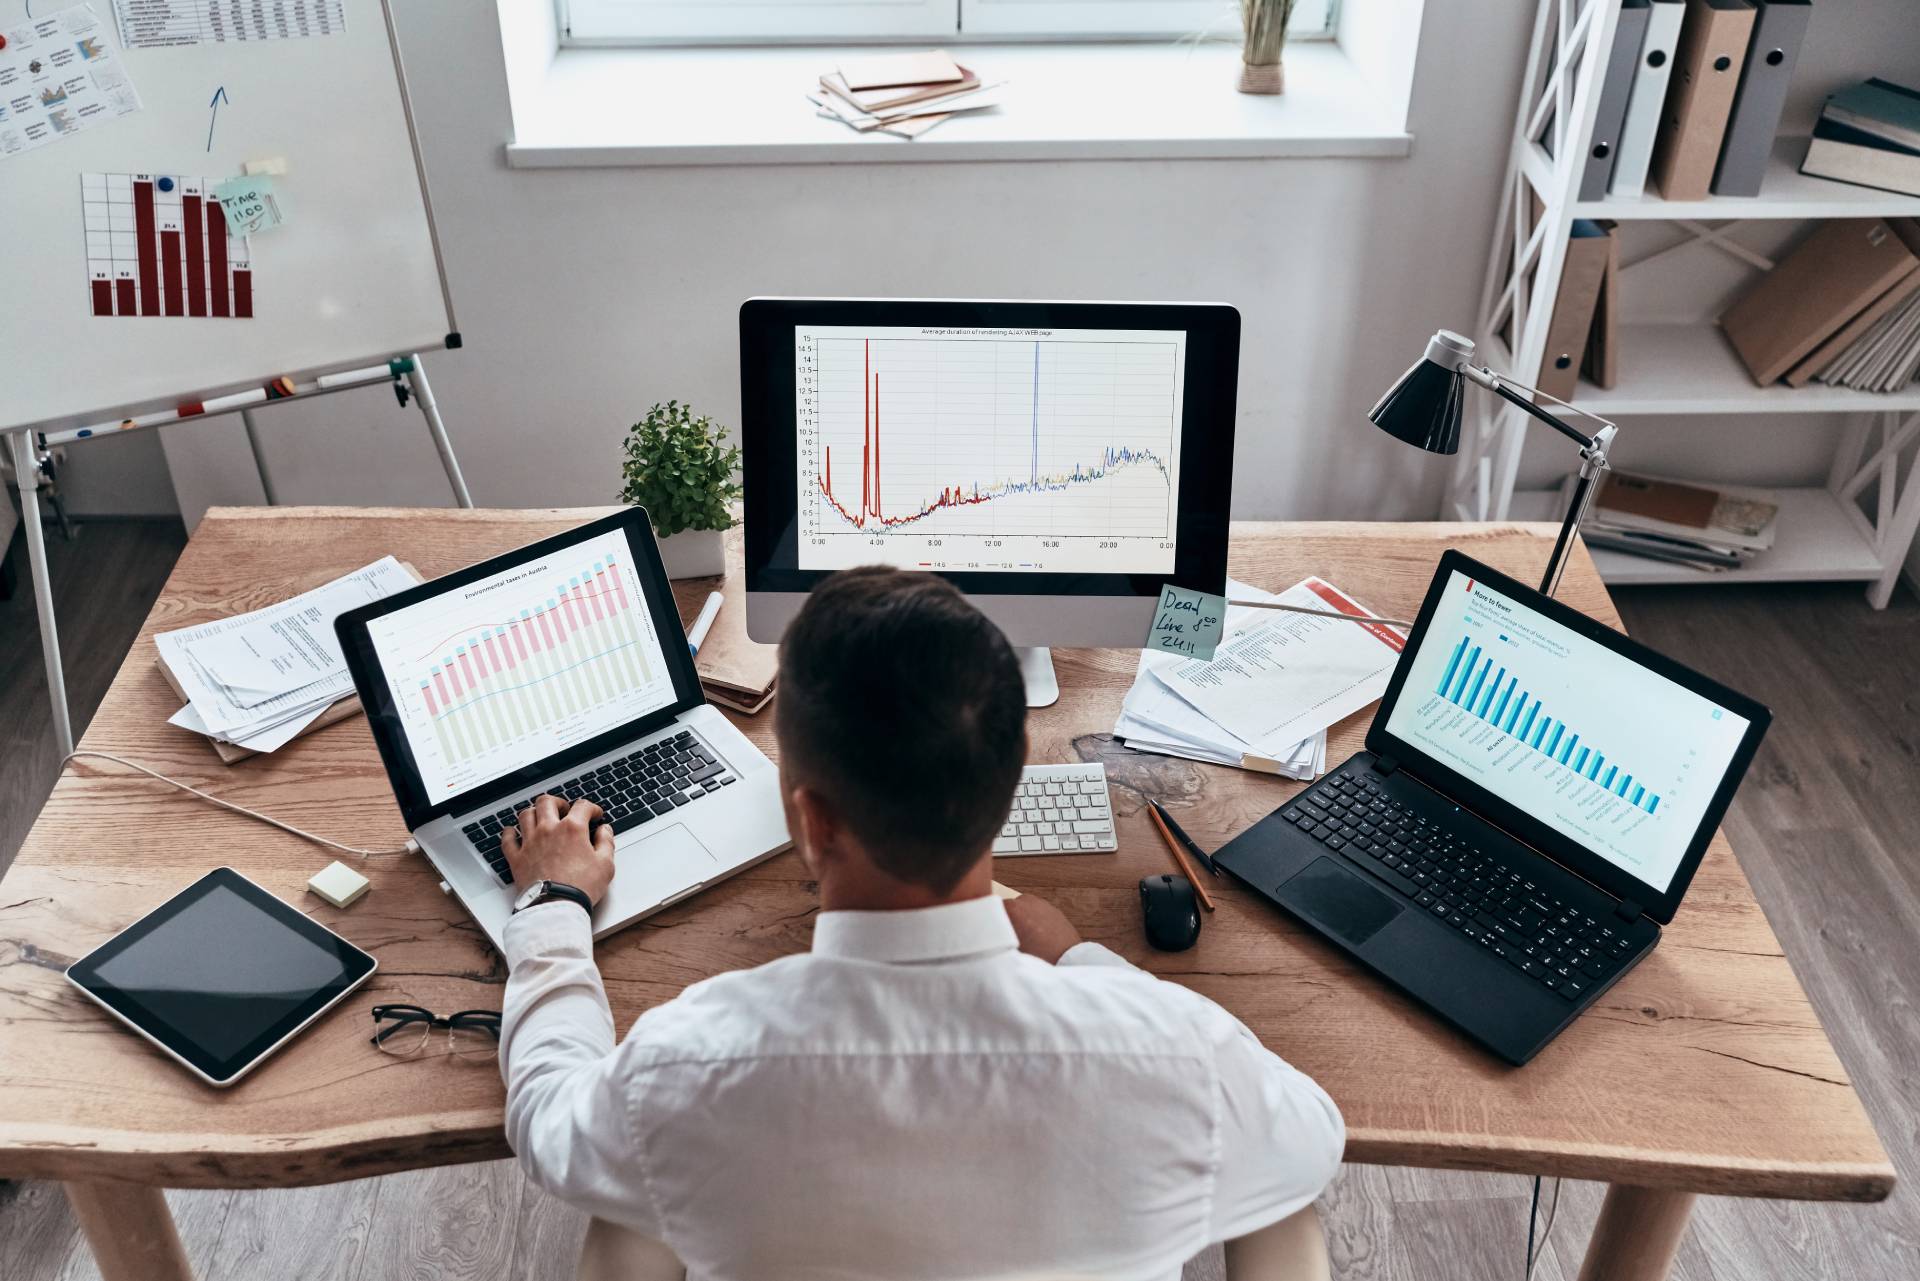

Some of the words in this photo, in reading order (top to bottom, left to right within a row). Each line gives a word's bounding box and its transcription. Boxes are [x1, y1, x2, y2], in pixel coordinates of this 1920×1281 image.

[465, 580, 505, 600] Environmental
[506, 575, 521, 584] taxes
[528, 565, 548, 576] Austria
[1164, 590, 1203, 616] Dead
[1474, 590, 1488, 602] More
[1496, 601, 1512, 613] fewer
[1161, 636, 1195, 654] 24.11
